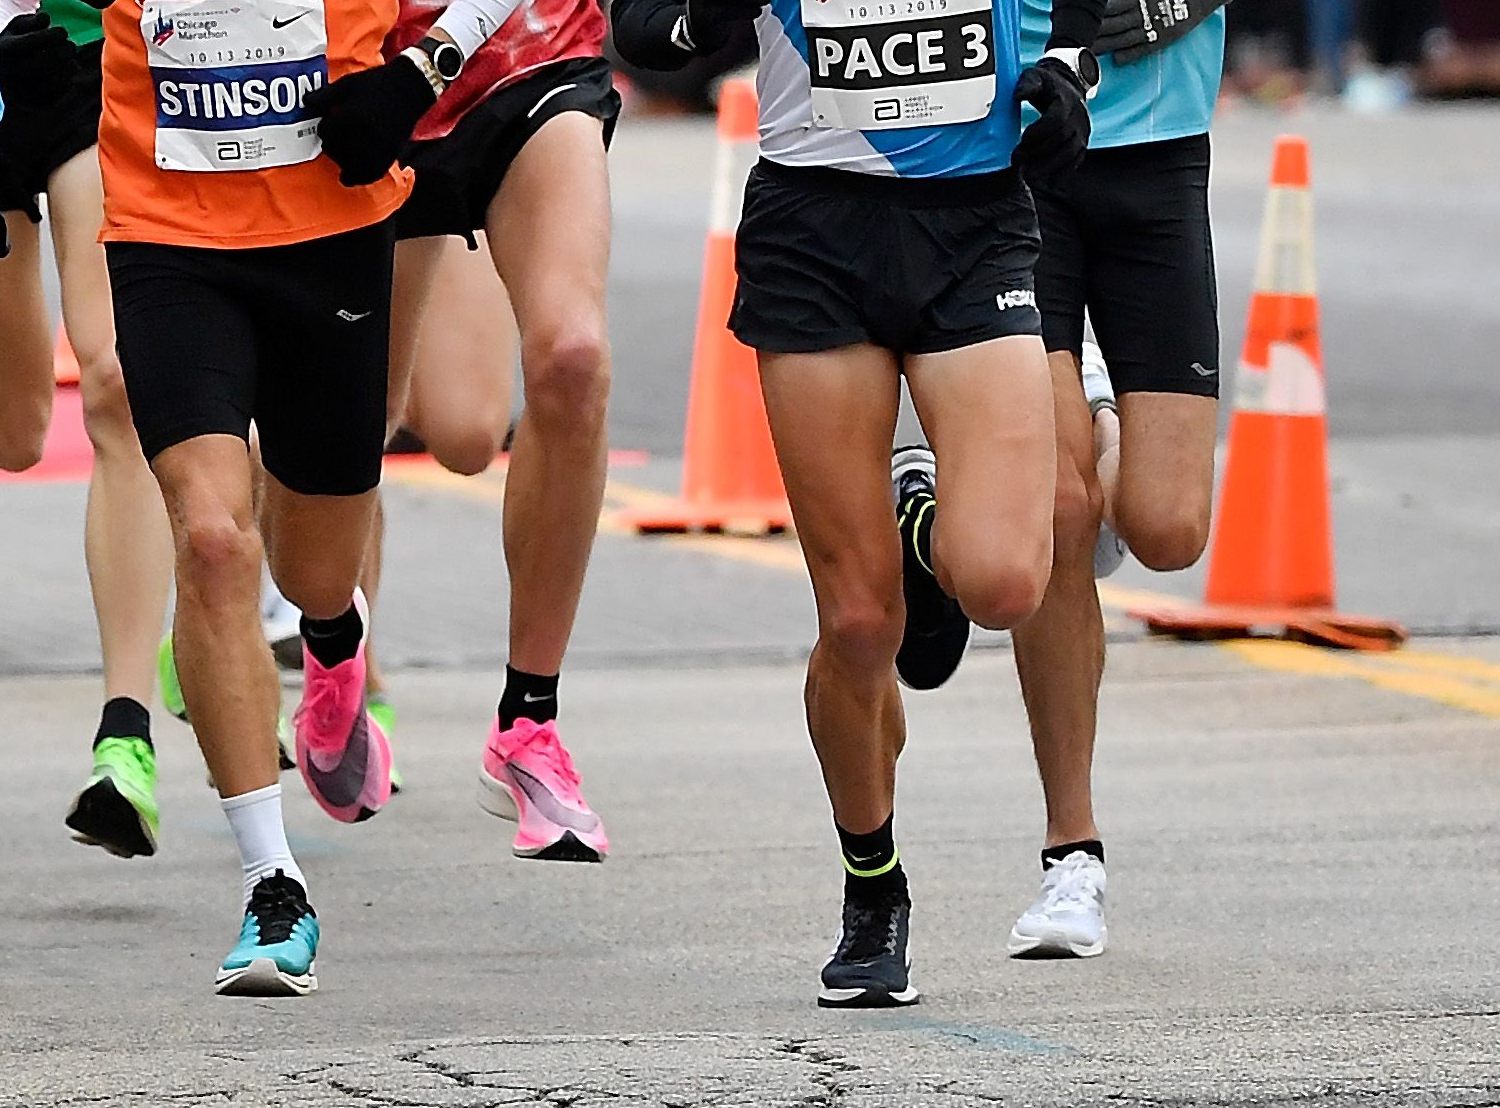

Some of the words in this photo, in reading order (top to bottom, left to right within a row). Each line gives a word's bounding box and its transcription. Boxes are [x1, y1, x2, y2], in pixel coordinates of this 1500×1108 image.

[176, 19, 218, 32] Chicago
[178, 30, 228, 41] Marathon
[190, 46, 285, 63] 10.13.2019
[815, 29, 947, 80] PACE
[960, 23, 989, 68] 3
[159, 71, 322, 119] STINSON
